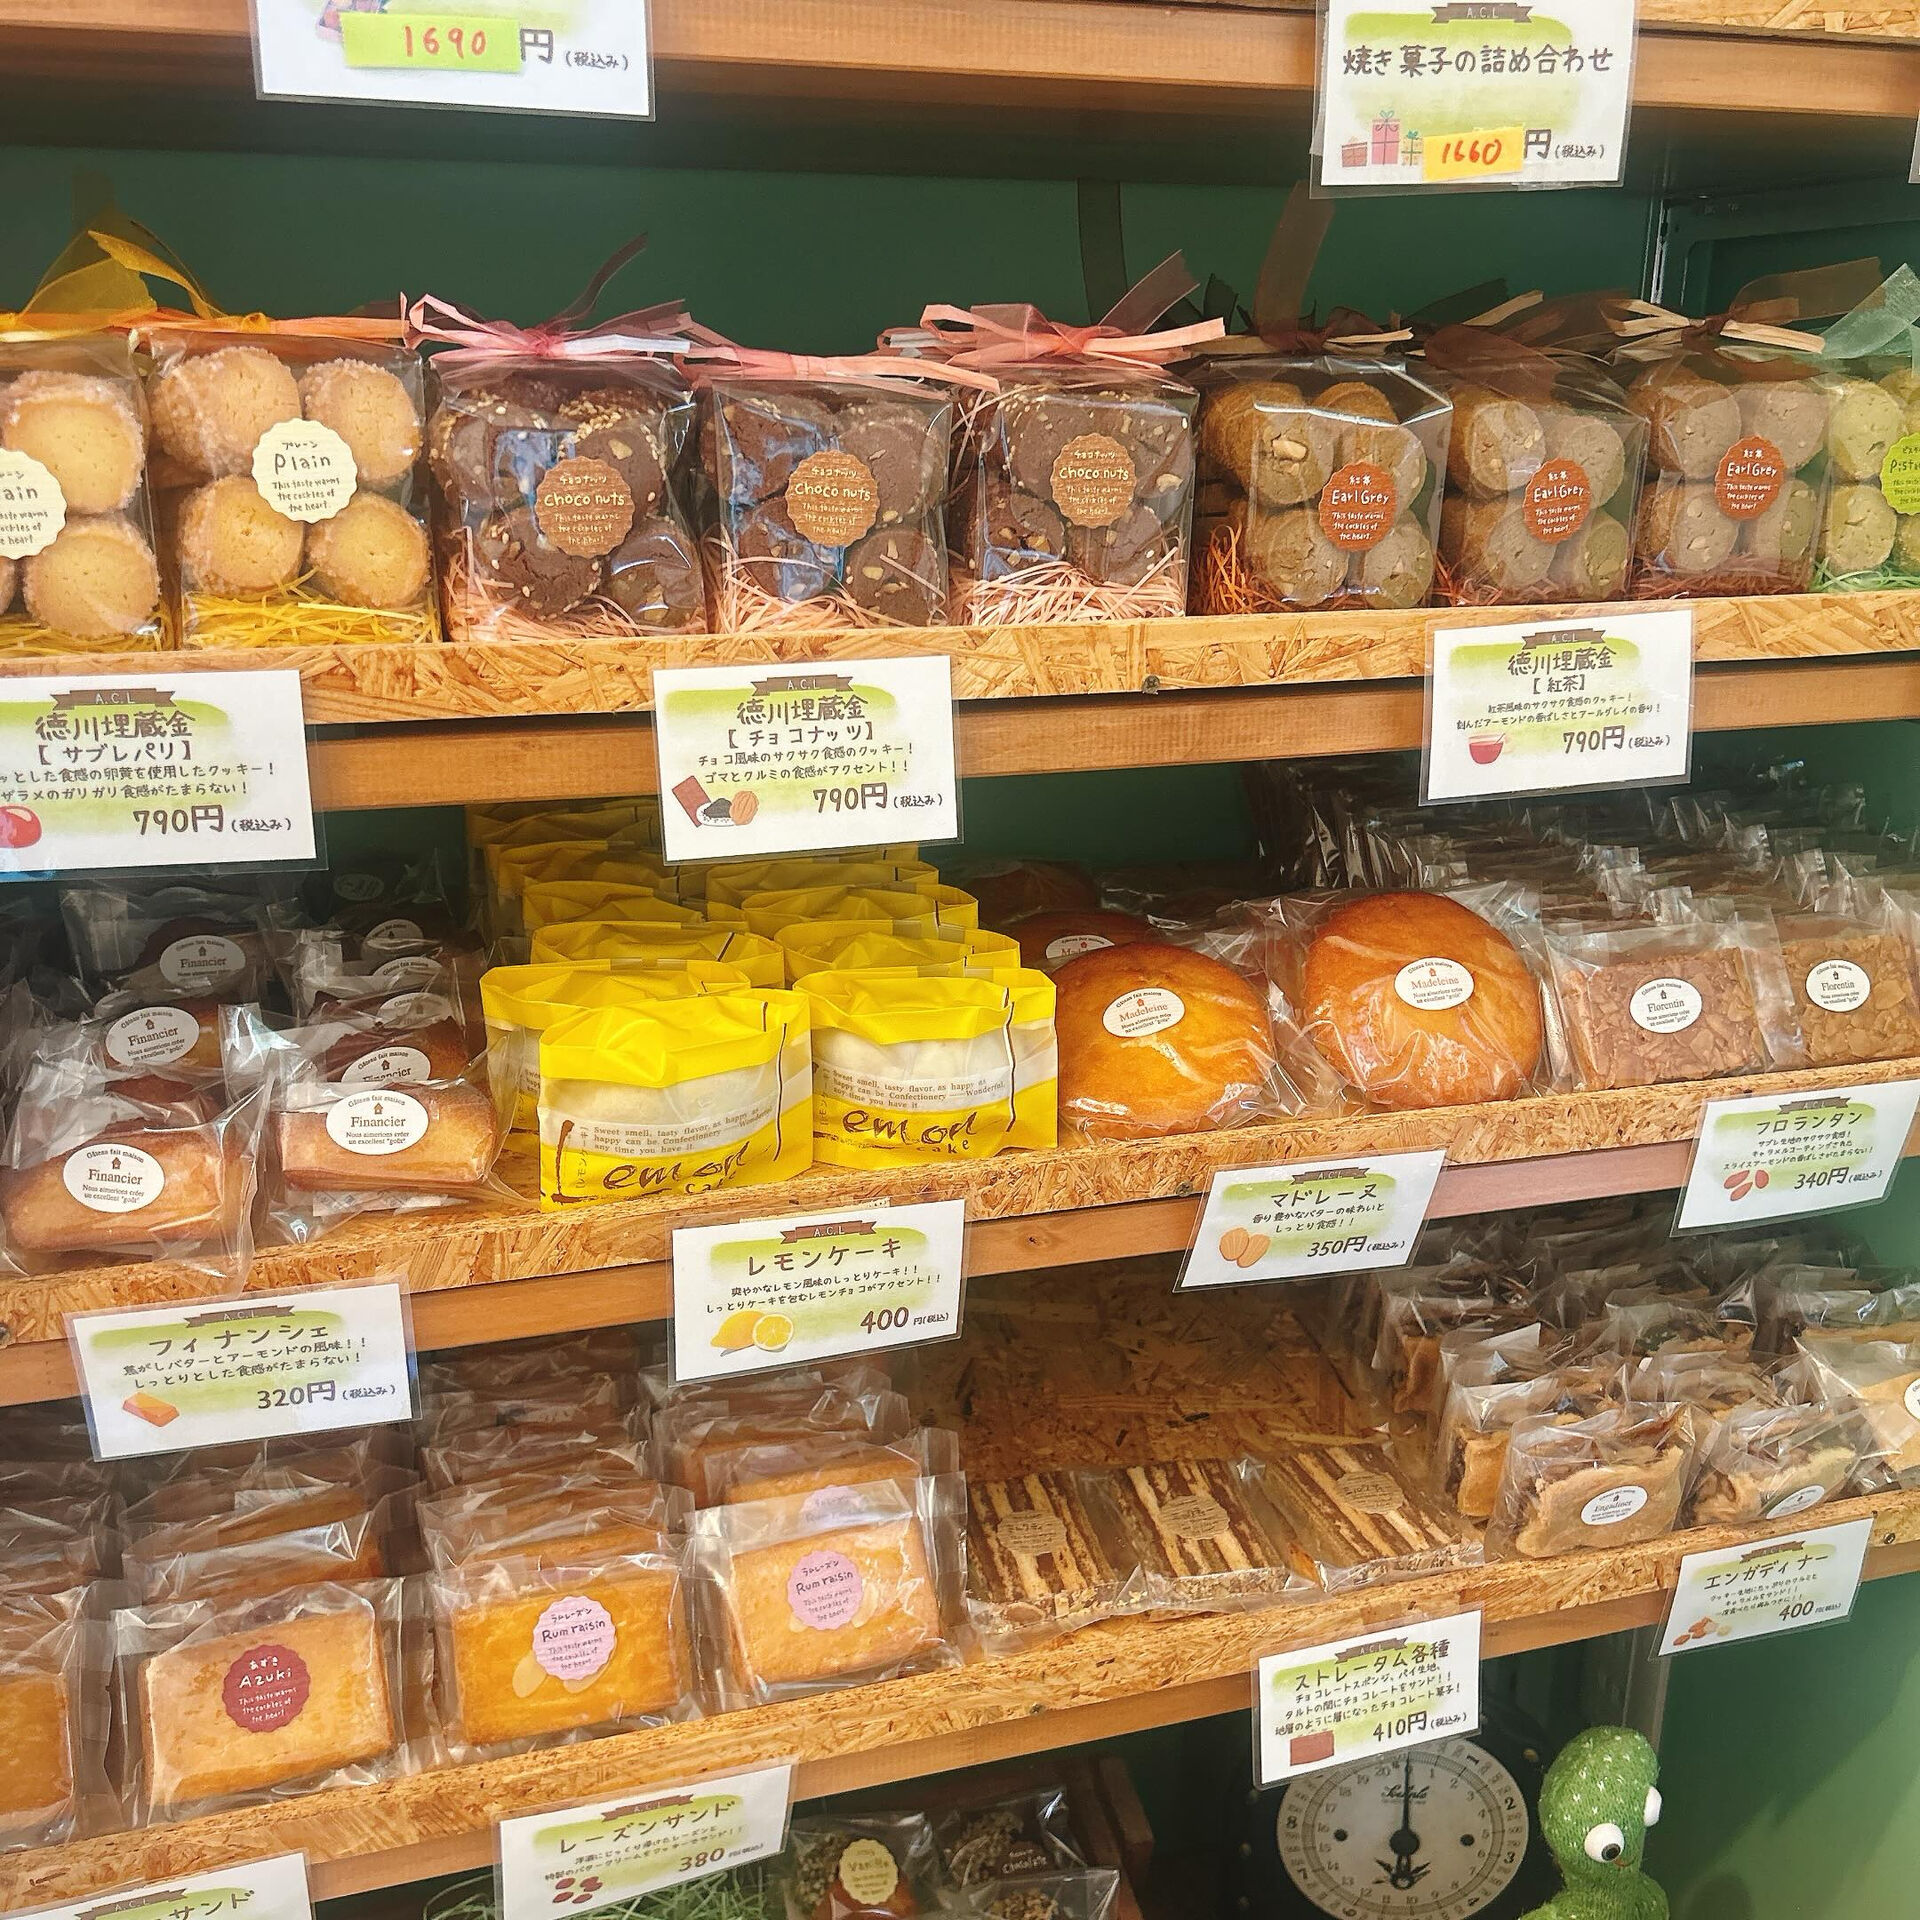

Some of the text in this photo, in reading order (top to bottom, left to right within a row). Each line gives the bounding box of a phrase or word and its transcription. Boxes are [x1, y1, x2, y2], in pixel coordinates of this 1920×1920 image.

[403, 25, 487, 60] 1690
[1342, 43, 1614, 78] 焼き菓子の詰め合わせ
[1441, 139, 1503, 164] 1660
[274, 453, 331, 475] Plain
[1726, 462, 1777, 477] Earl Grey
[1331, 490, 1389, 505] Earl Grey
[1533, 484, 1584, 502] Earl Grey
[1506, 645, 1617, 676] 徳川埋蔵金
[1532, 674, 1586, 695] 【紅茶】
[736, 694, 869, 725] 徳川埋蔵金
[35, 710, 196, 741] 徳川埋蔵金
[728, 721, 874, 749] 【チョコナッツ】
[1562, 724, 1626, 754] 790円
[38, 740, 192, 765] 【サブレパリ】
[812, 782, 888, 813] 790円
[132, 804, 224, 836] 790円
[1410, 976, 1460, 990] Madeleine
[1119, 1003, 1169, 1022] Madeleine
[1647, 999, 1686, 1013] Florentin
[128, 1026, 179, 1046] Financier
[869, 1098, 884, 1106] you
[888, 1100, 908, 1108] have
[350, 1116, 407, 1127] Financier
[1755, 1111, 1863, 1135] フロランタン
[88, 1168, 143, 1185] Financier
[1793, 1166, 1850, 1190] 340円
[1270, 1183, 1378, 1209] マドレーヌ
[748, 1238, 902, 1277] レモンケーキ
[1307, 1235, 1368, 1258] 350円
[860, 1306, 910, 1335] 400
[148, 1323, 330, 1357] フィナンシェ
[256, 1379, 336, 1410] 320円
[795, 1571, 854, 1595] Rum raisin
[1703, 1554, 1829, 1591] エンガディナー
[1778, 1600, 1815, 1621] 400
[541, 1620, 606, 1642] Rum raisin
[1295, 1638, 1451, 1691] ストレータム各種
[239, 1667, 292, 1689] Azuki
[1372, 1710, 1427, 1742] 410円
[560, 1800, 736, 1854] レーズンサンド
[678, 1847, 726, 1873] 380
